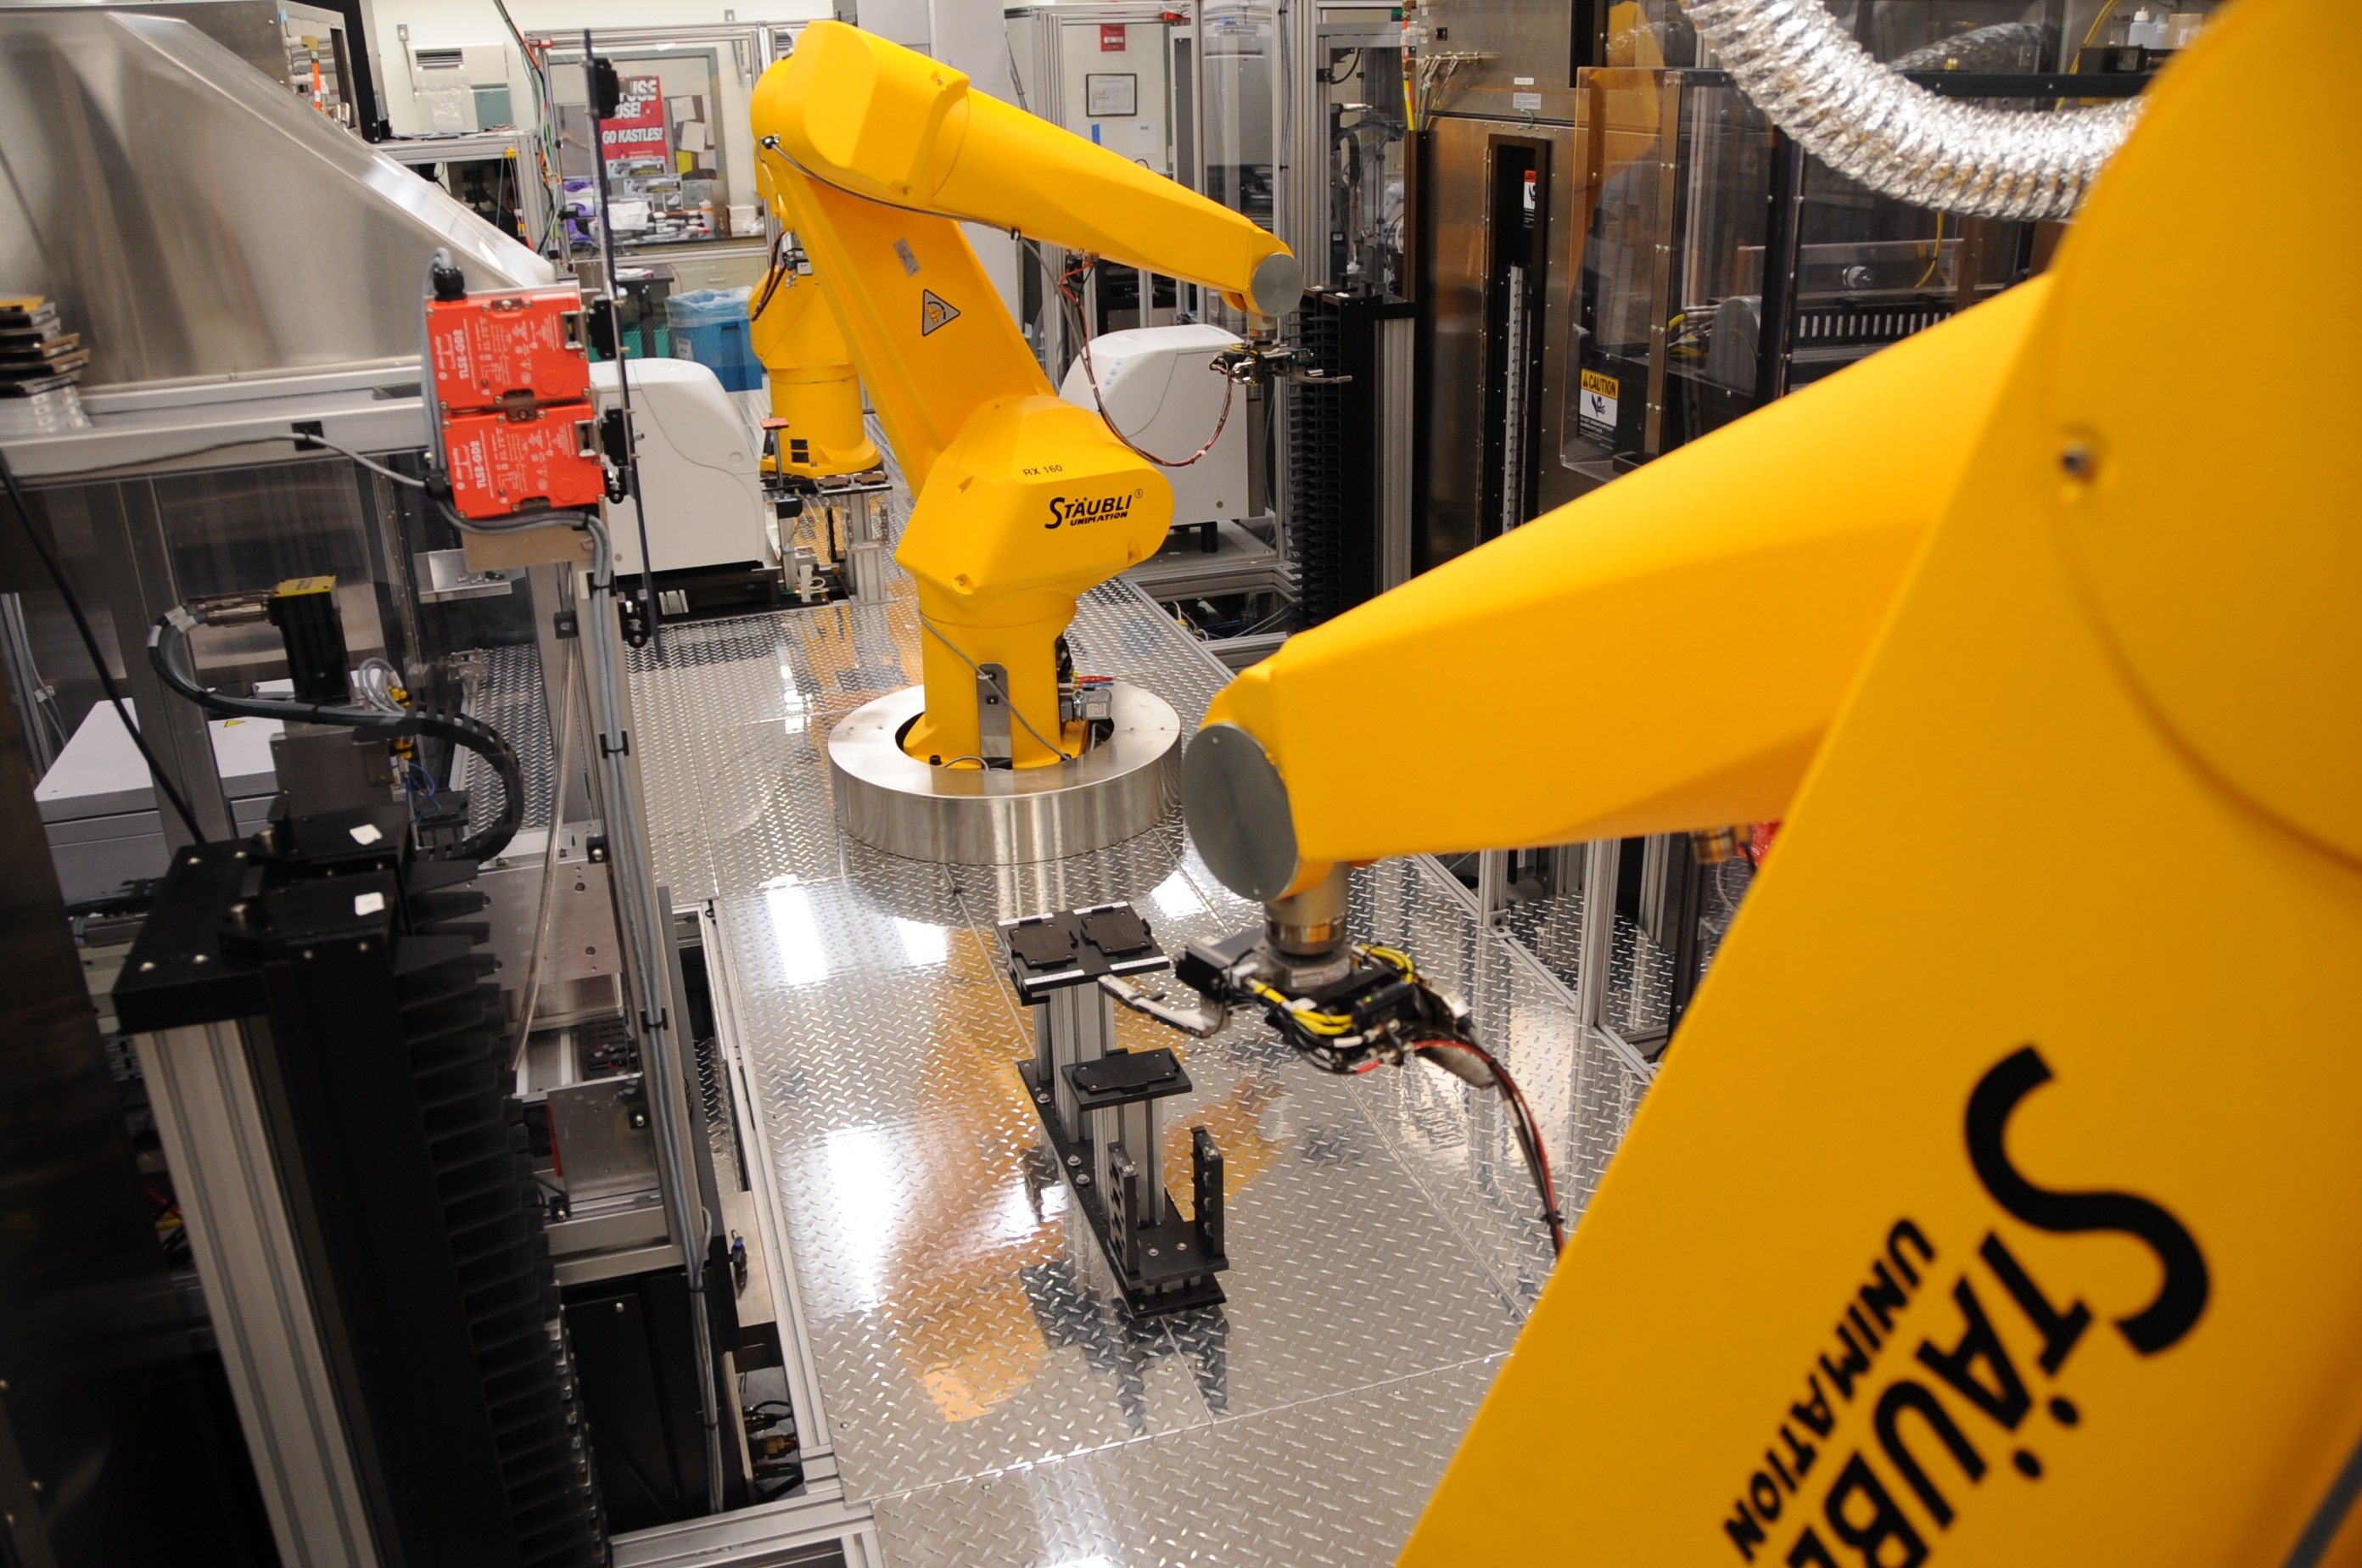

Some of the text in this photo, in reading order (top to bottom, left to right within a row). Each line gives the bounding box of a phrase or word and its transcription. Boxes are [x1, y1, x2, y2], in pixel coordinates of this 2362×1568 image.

[602, 126, 663, 144] GO KASTLES!
[1588, 374, 1616, 397] CAUTION
[1022, 464, 1063, 477] RX 160
[1069, 511, 1128, 526] UNIMATION
[1721, 1217, 1938, 1565] UNIMATION
